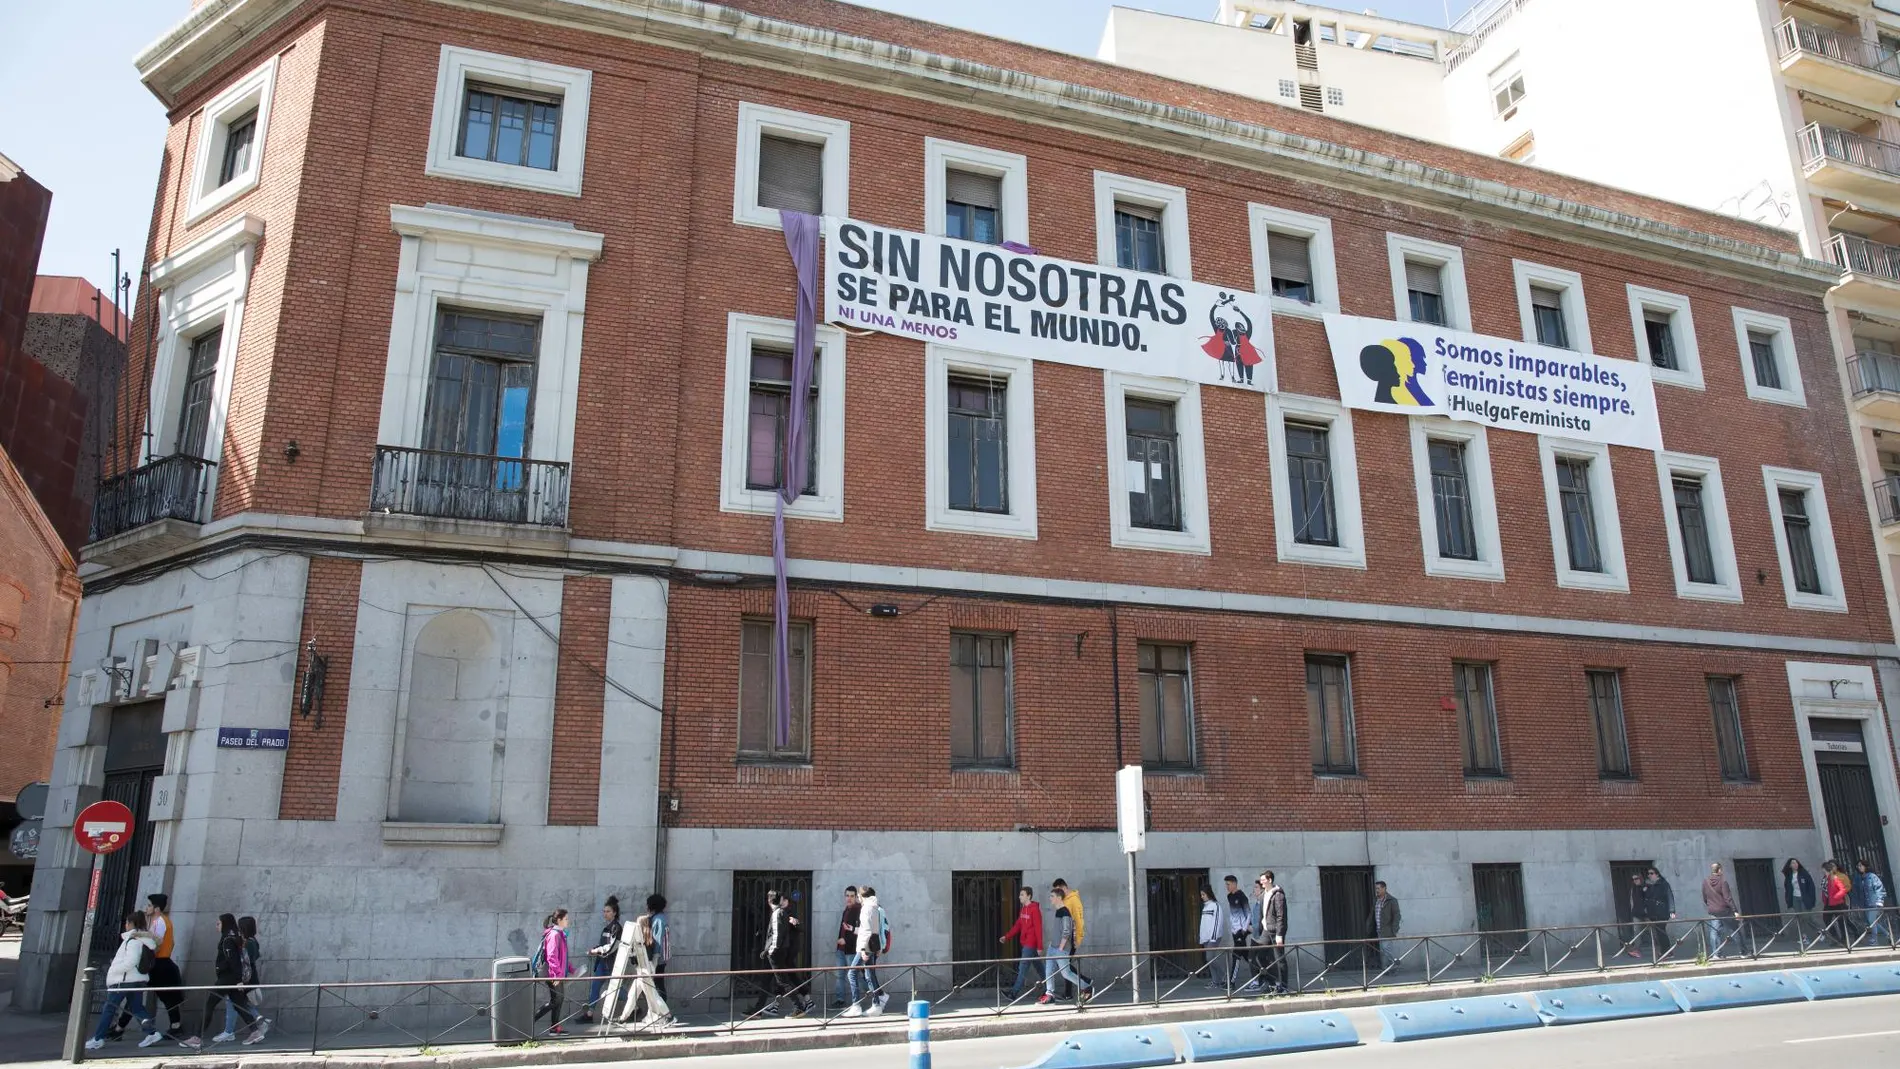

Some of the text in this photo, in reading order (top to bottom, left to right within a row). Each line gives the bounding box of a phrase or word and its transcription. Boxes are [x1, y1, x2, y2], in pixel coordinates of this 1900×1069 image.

[838, 223, 1187, 325] SIN NOSOTRAS
[837, 272, 1148, 353] SE PARA EL MUNDO.
[838, 306, 957, 340] NI UNA MENOS
[1435, 337, 1627, 392] Somos imparables,
[1448, 394, 1591, 432] HuelgaFeminista
[1553, 388, 1635, 416] siempre.
[220, 737, 285, 747] PASEO DEL PRADO
[157, 790, 168, 806] 30
